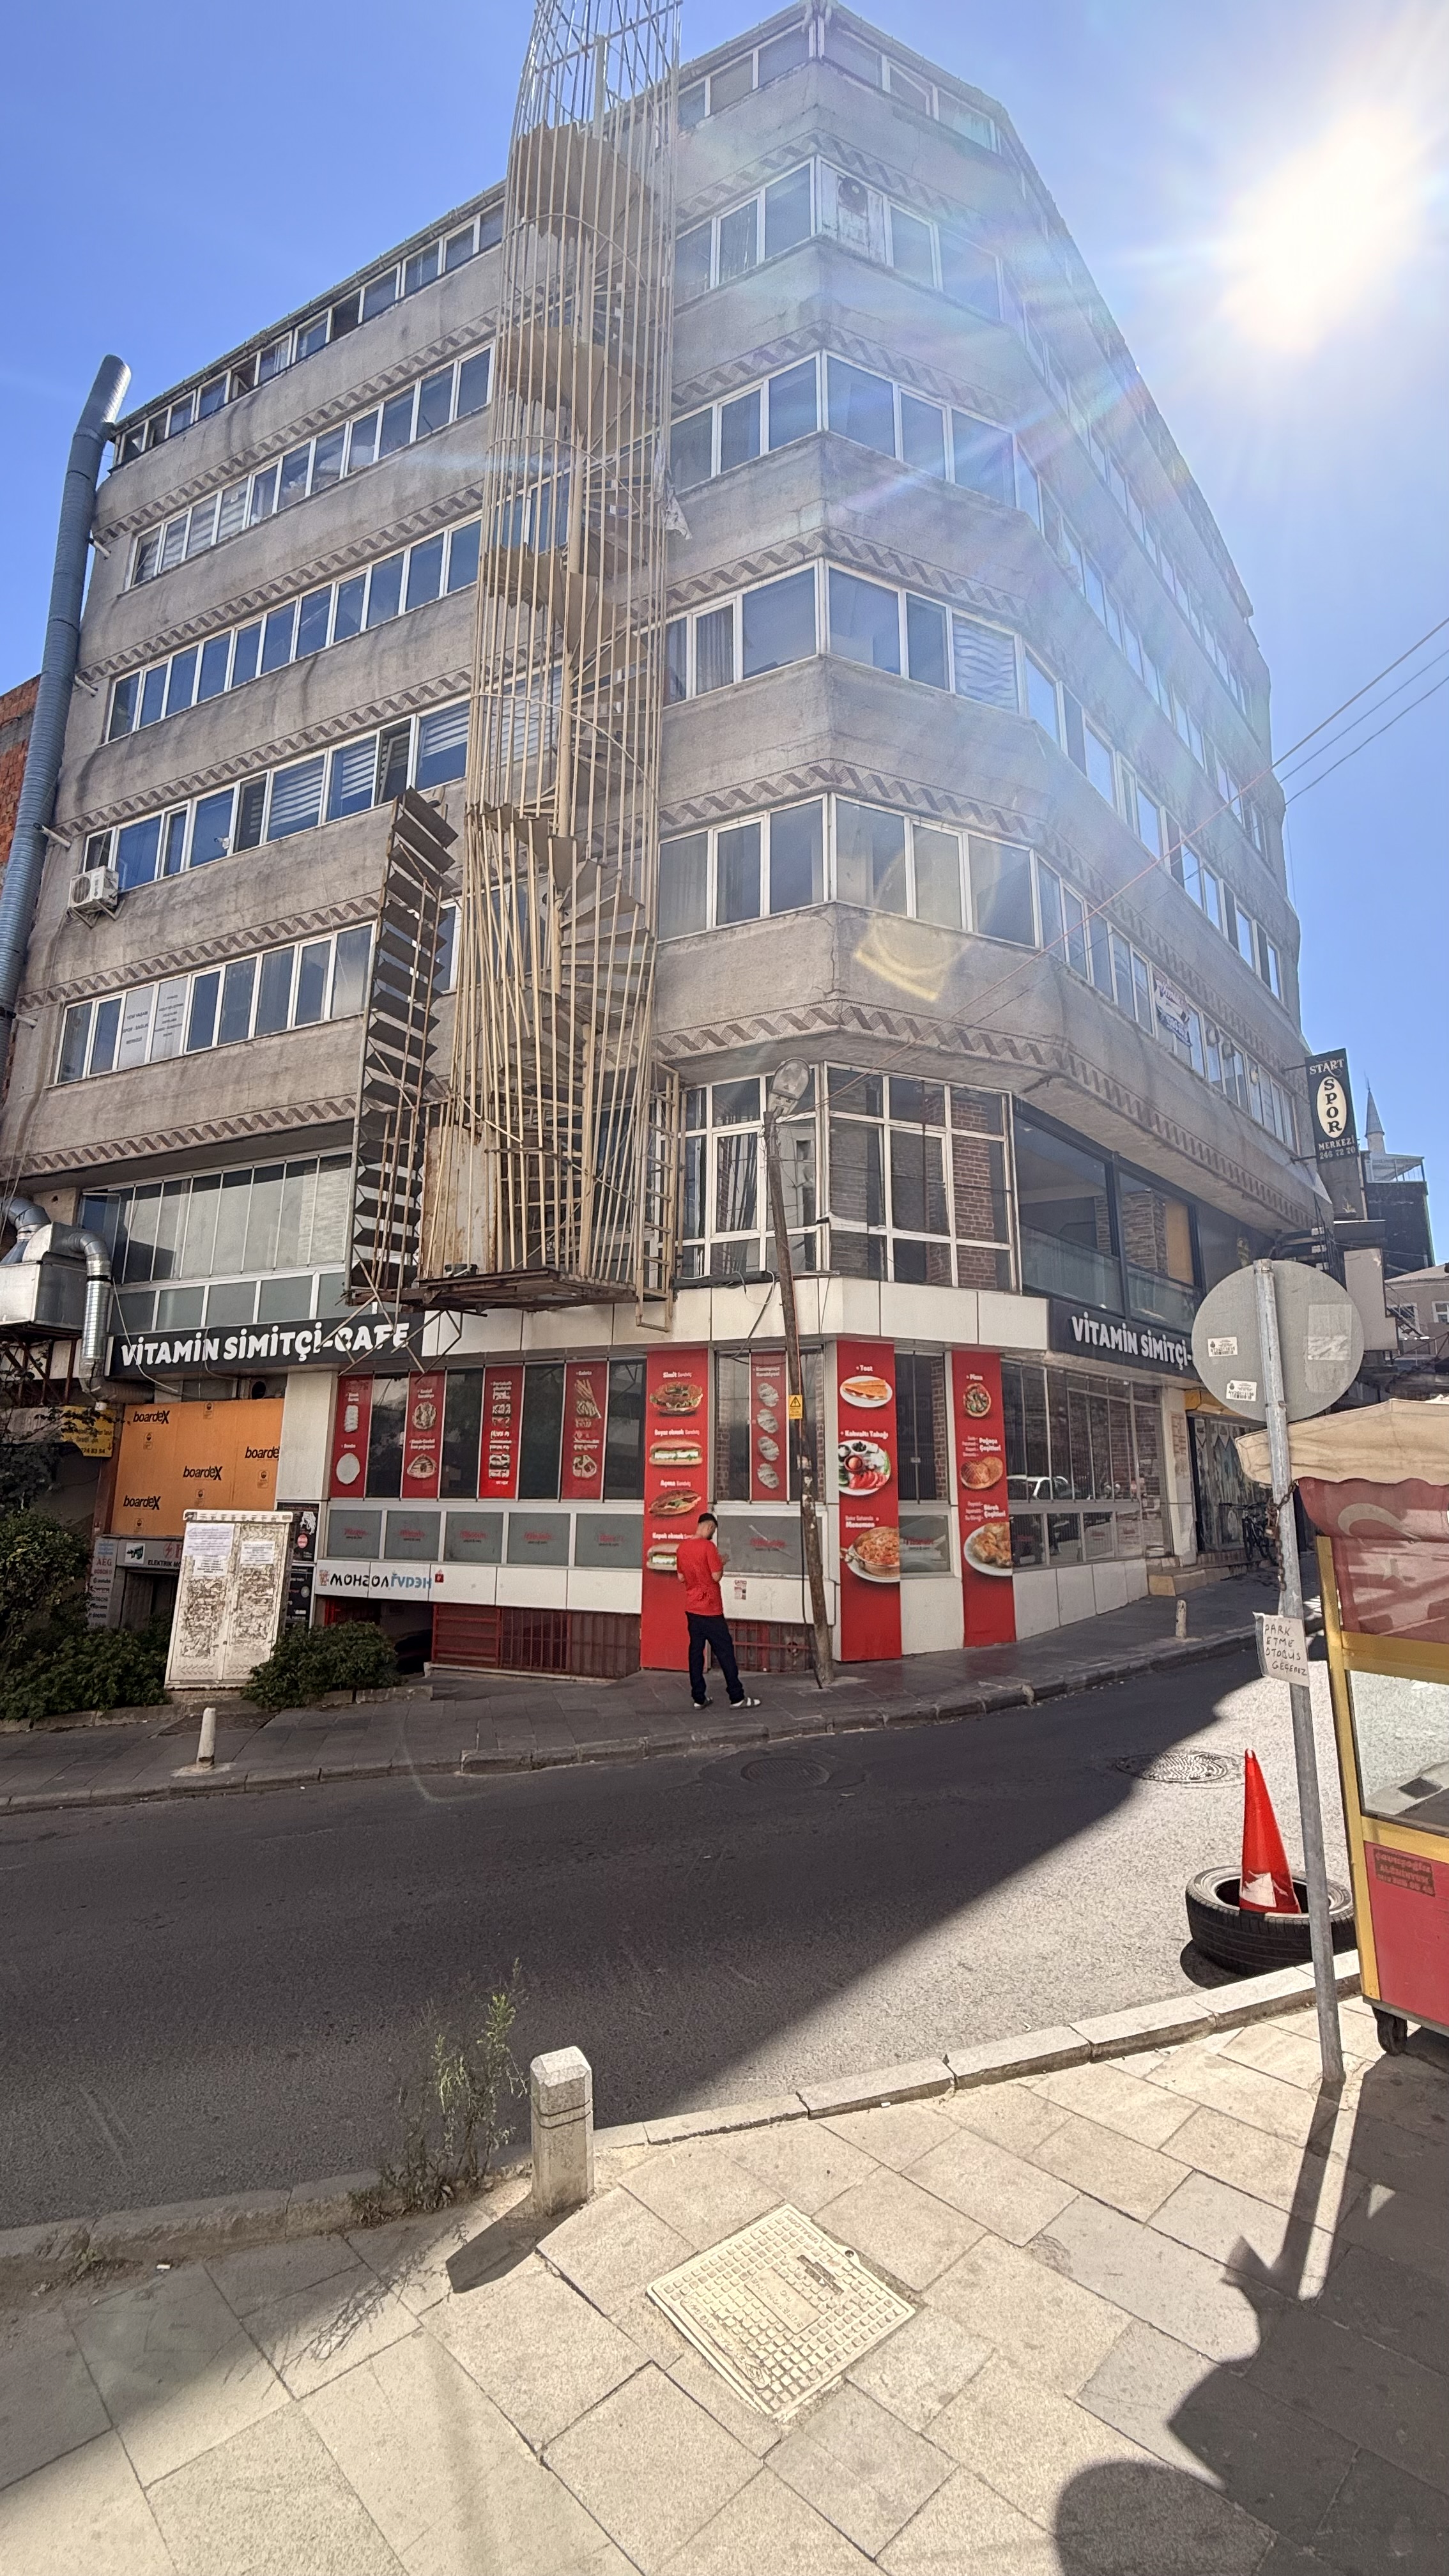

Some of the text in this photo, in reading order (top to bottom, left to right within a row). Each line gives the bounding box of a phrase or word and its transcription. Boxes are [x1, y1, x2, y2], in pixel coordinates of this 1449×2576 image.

[1310, 1059, 1344, 1077] START
[1324, 1078, 1342, 1133] SPOR
[1318, 1134, 1355, 1151] MERKEZİ
[121, 1333, 220, 1366] VİTAMİN
[1071, 1312, 1192, 1370] VİTAMİN SİMİTÇİ-
[245, 1446, 280, 1460] boarde
[1265, 1623, 1291, 1636] PARK
[1266, 1636, 1295, 1648] ETME
